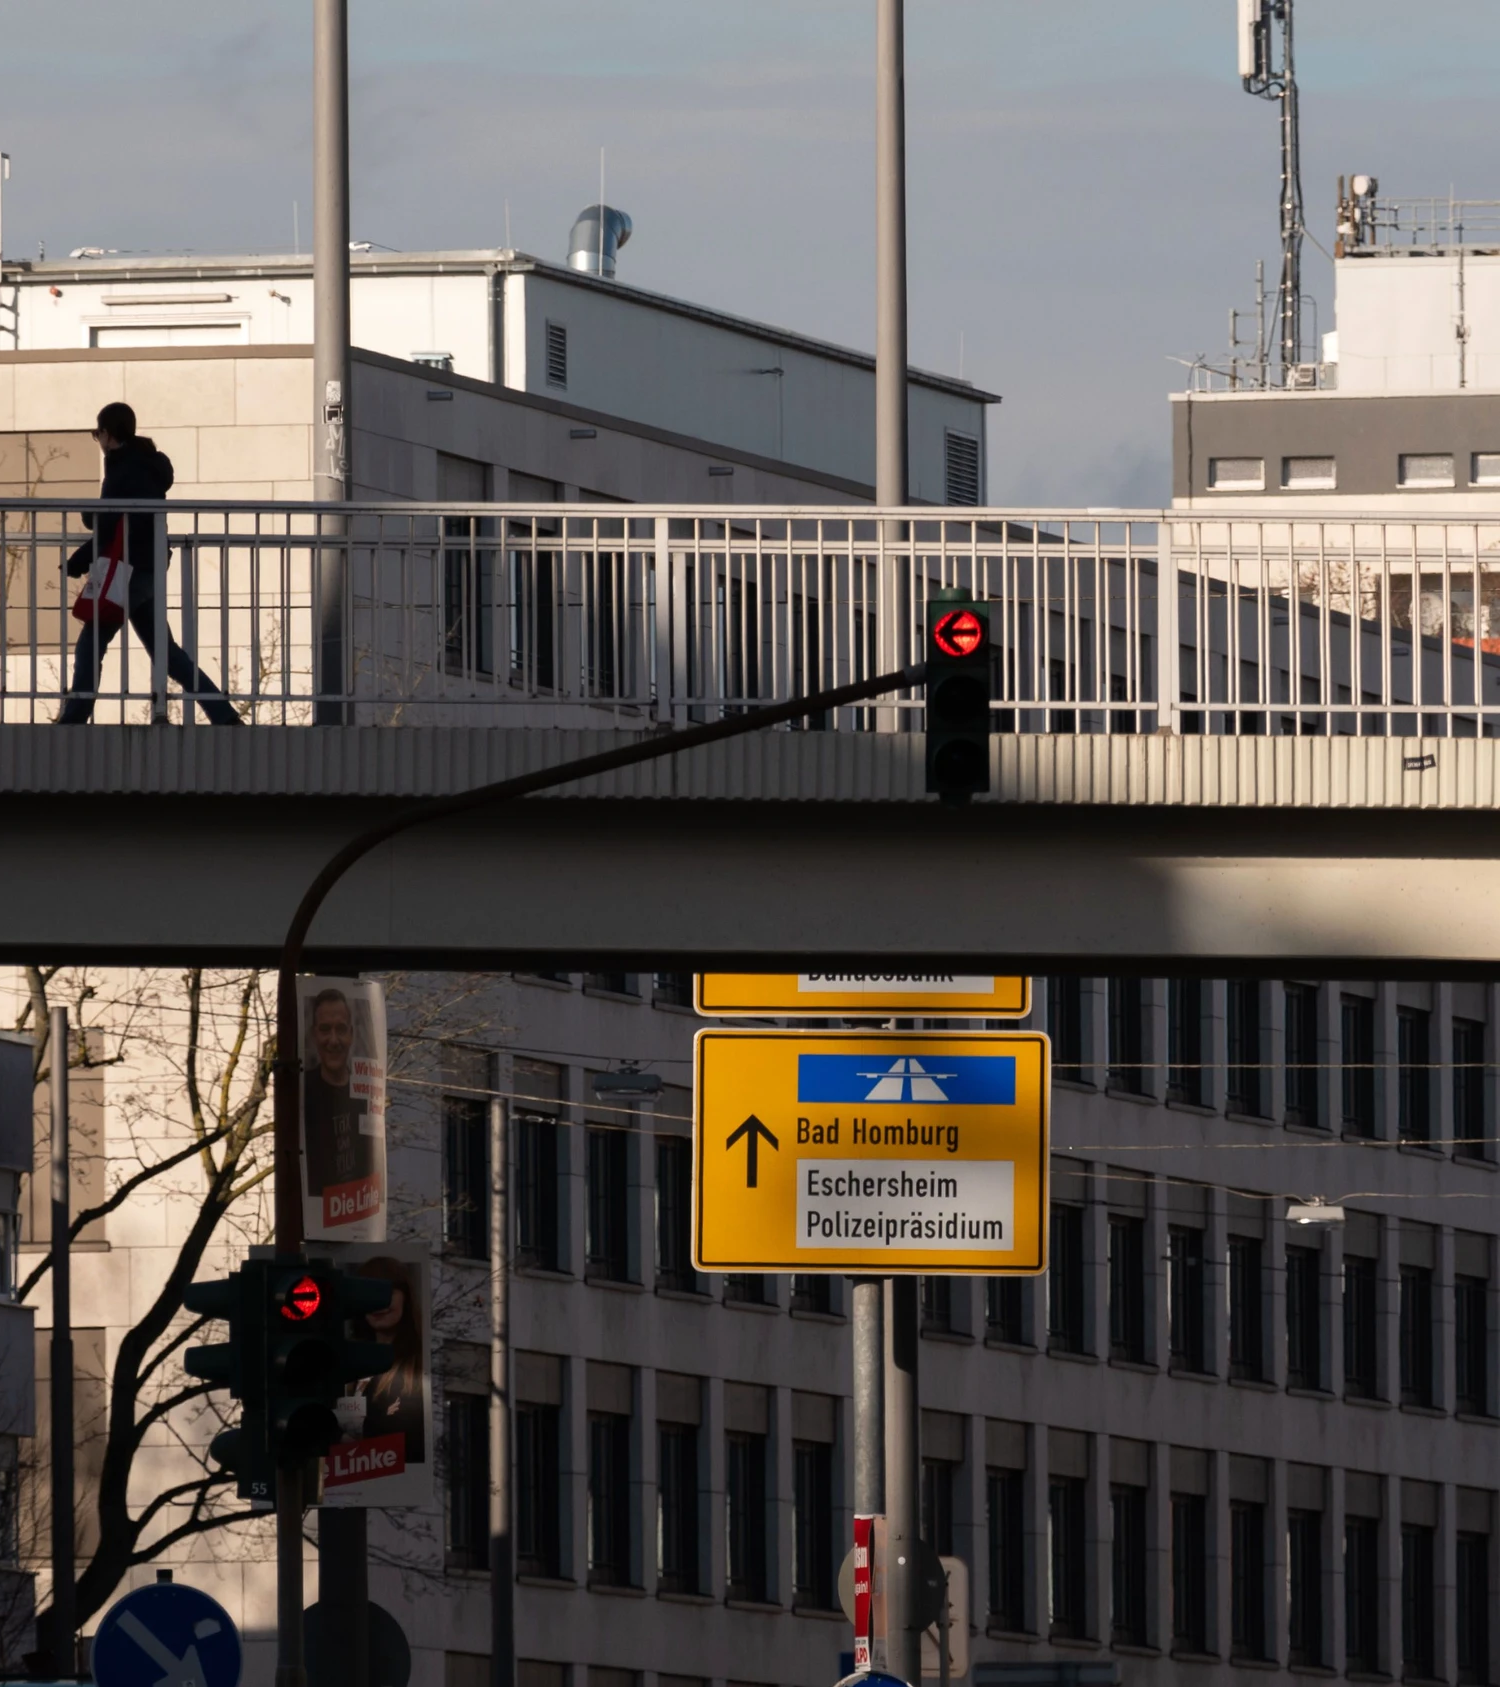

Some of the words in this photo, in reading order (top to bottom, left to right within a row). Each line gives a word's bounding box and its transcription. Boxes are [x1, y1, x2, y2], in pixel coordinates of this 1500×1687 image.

[796, 1117, 840, 1145] Bad
[852, 1117, 960, 1153] Homburg
[807, 1169, 958, 1198] Eschersheim
[329, 1192, 355, 1218] Die
[807, 1210, 1004, 1246] Polizeipräsidium
[339, 1400, 361, 1411] nek
[334, 1446, 396, 1477] Linke
[251, 1482, 267, 1495] 55
[854, 1542, 867, 1568] ism
[855, 1647, 867, 1663] LPD
